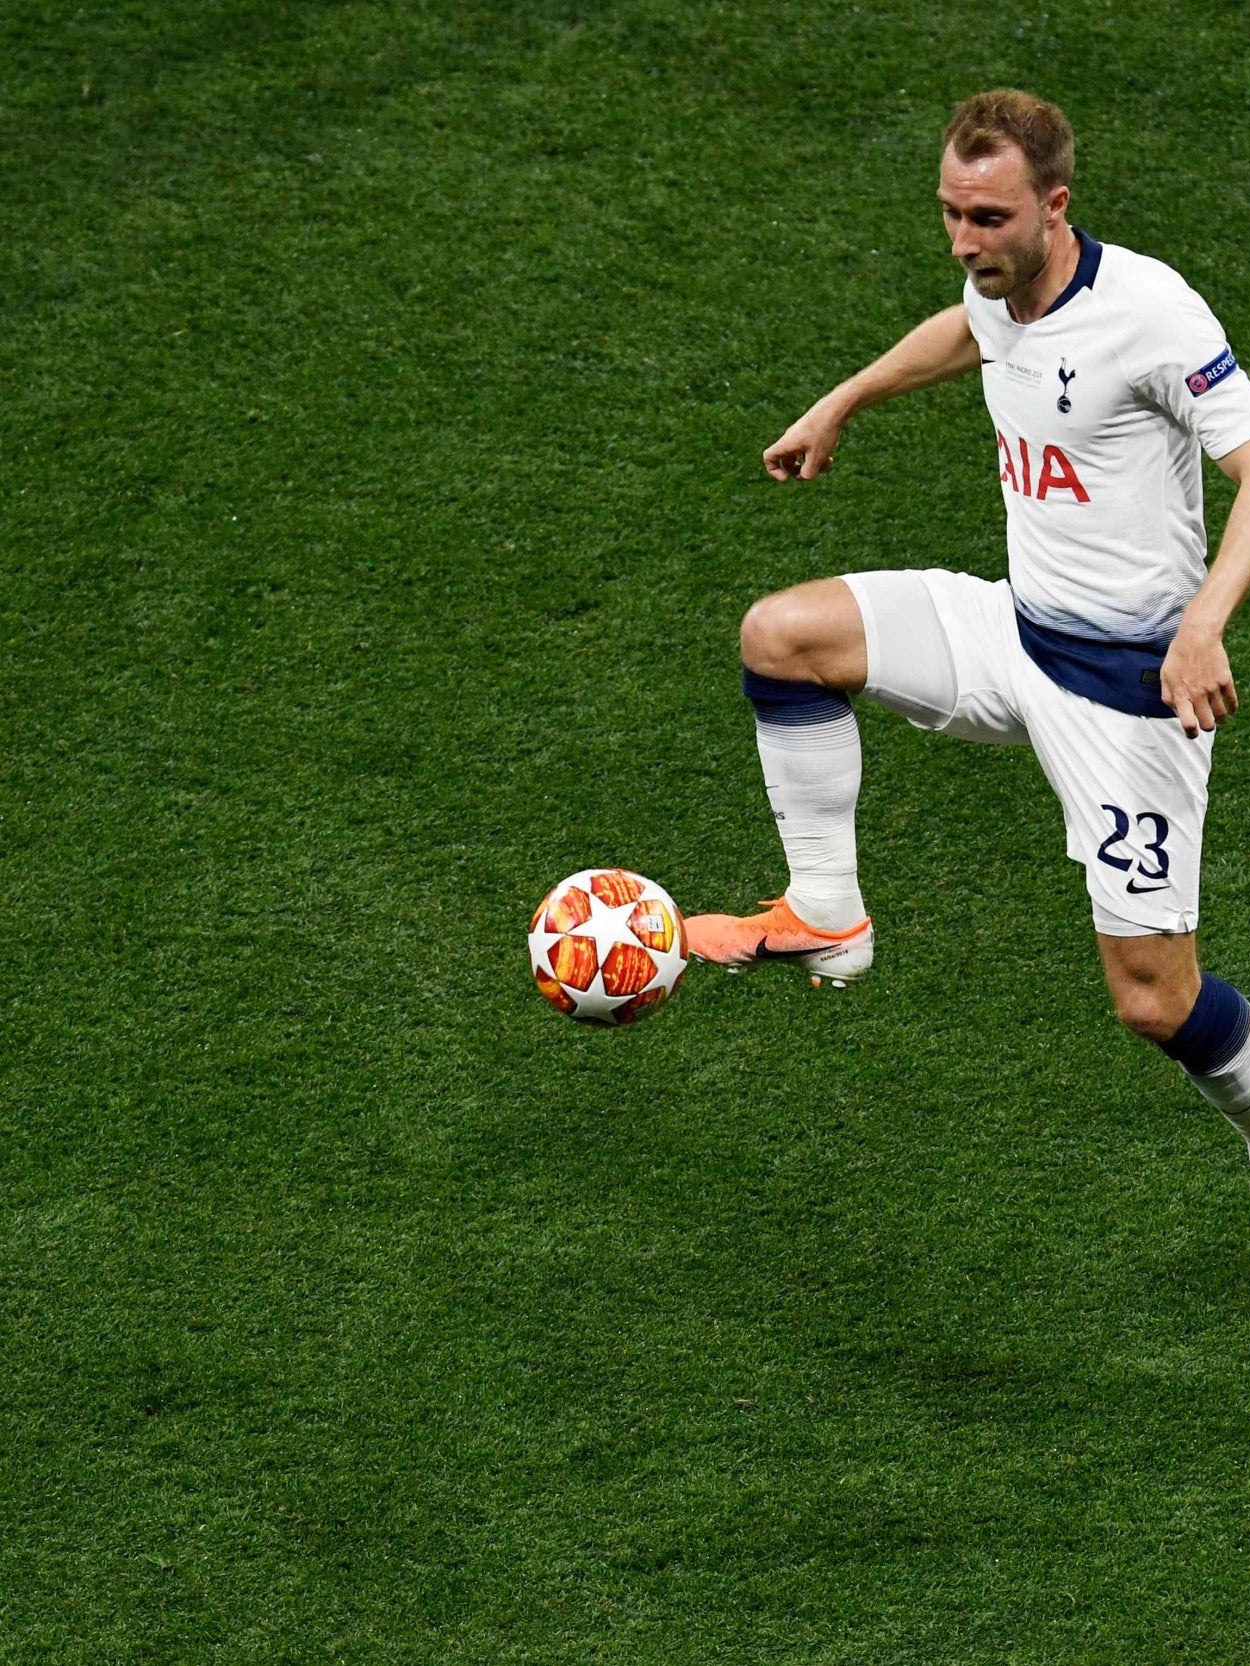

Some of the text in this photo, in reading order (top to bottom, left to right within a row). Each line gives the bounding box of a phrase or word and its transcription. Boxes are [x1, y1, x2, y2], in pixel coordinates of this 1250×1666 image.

[1205, 354, 1236, 381] RESPEC
[997, 428, 1091, 502] AIA
[1097, 804, 1169, 879] 23
